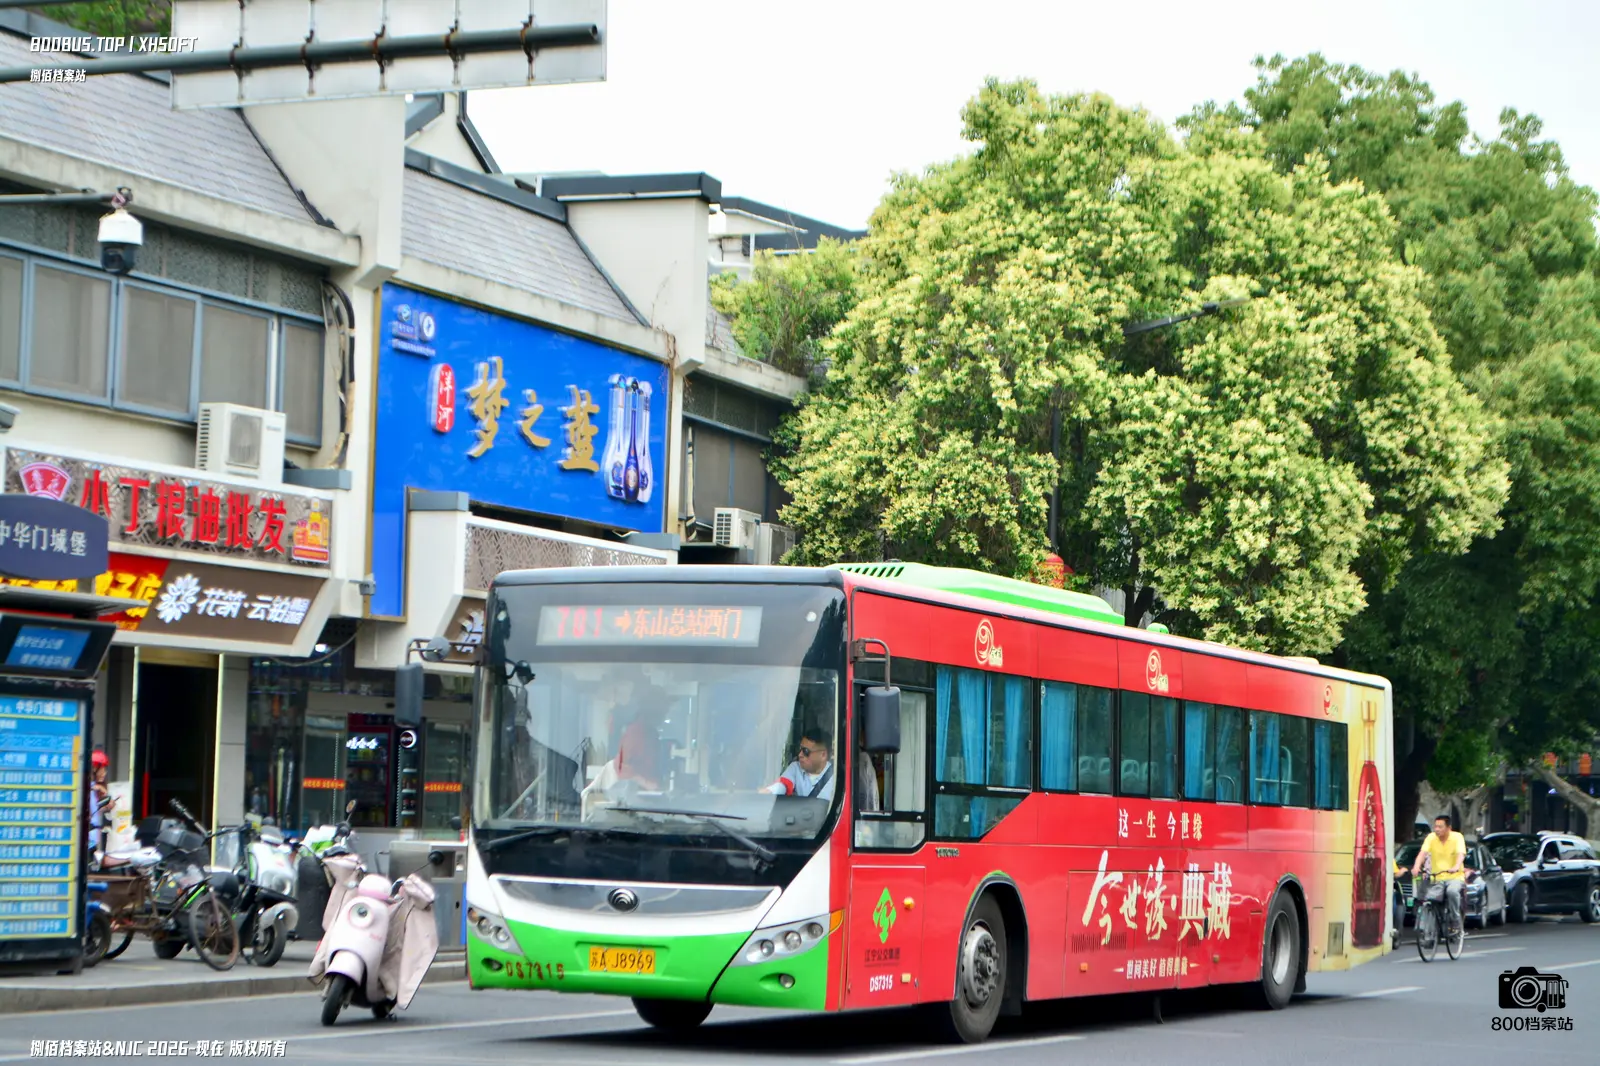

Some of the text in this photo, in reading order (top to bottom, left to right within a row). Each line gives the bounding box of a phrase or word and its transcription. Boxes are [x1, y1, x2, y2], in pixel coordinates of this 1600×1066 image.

[438, 369, 454, 431] 洋河
[463, 356, 601, 473] 梦之蓝
[80, 469, 288, 555] 小丁粮油批发
[0, 520, 88, 557] 中华门城堡
[557, 605, 743, 639] 701 东山总站西门
[1118, 808, 1203, 842] 这一生 今世缘
[869, 974, 893, 992] DS7315
[1126, 958, 1158, 980] 世间美好
